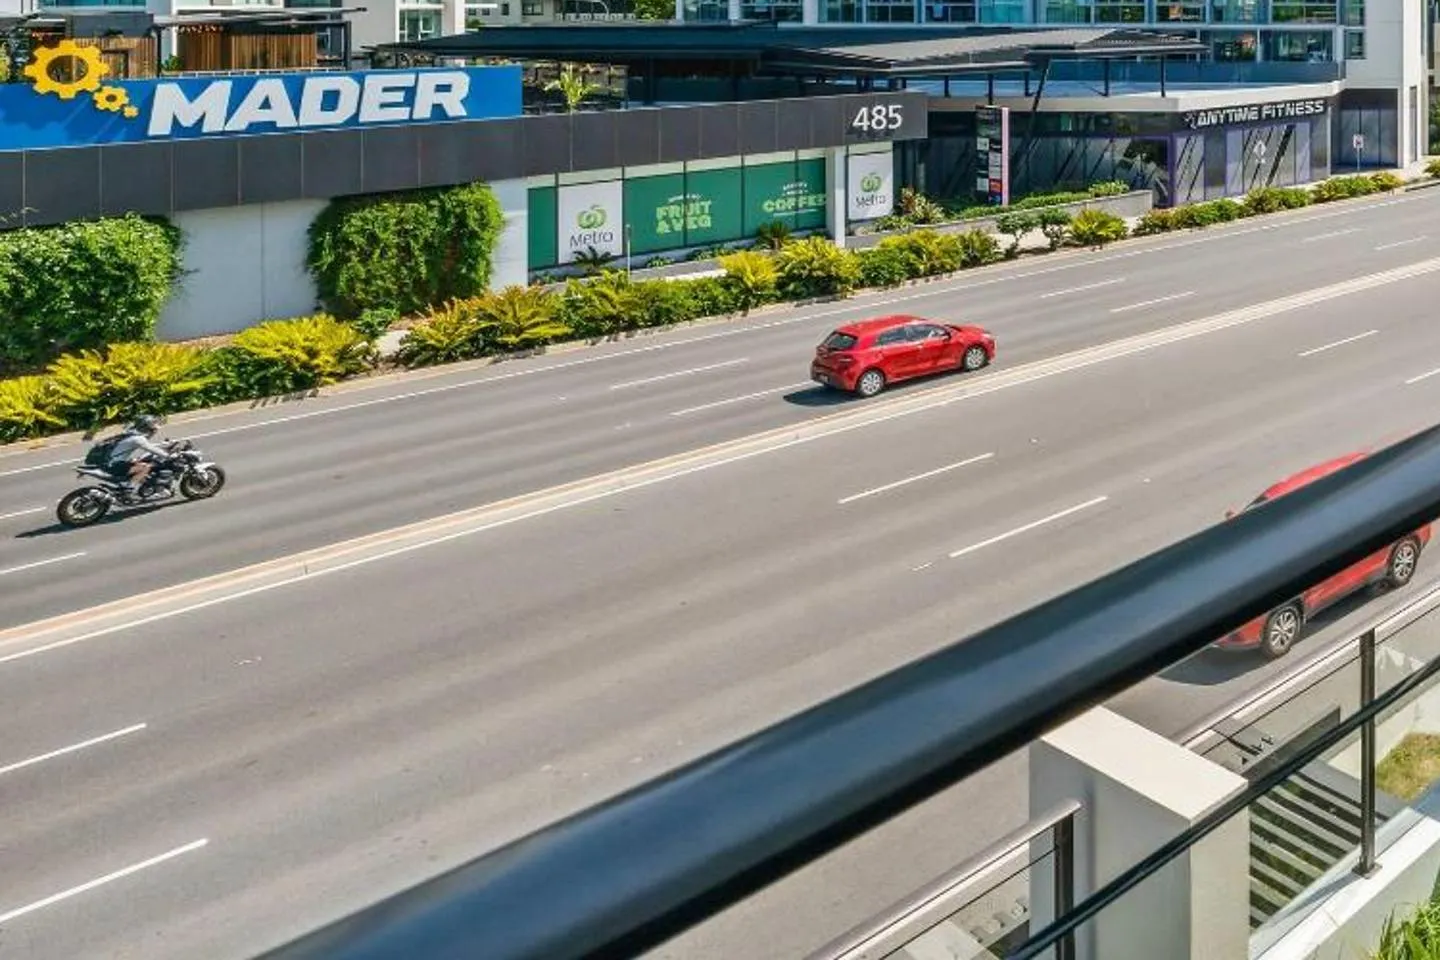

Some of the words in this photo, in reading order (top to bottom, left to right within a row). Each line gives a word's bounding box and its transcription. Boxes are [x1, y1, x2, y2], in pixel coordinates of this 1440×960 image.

[148, 70, 470, 137] MADER
[1197, 106, 1259, 127] ANYTIME
[1262, 100, 1325, 120] FITNESS
[852, 105, 903, 131] 485
[656, 200, 712, 220] FRUIT
[570, 230, 614, 249] Metro
